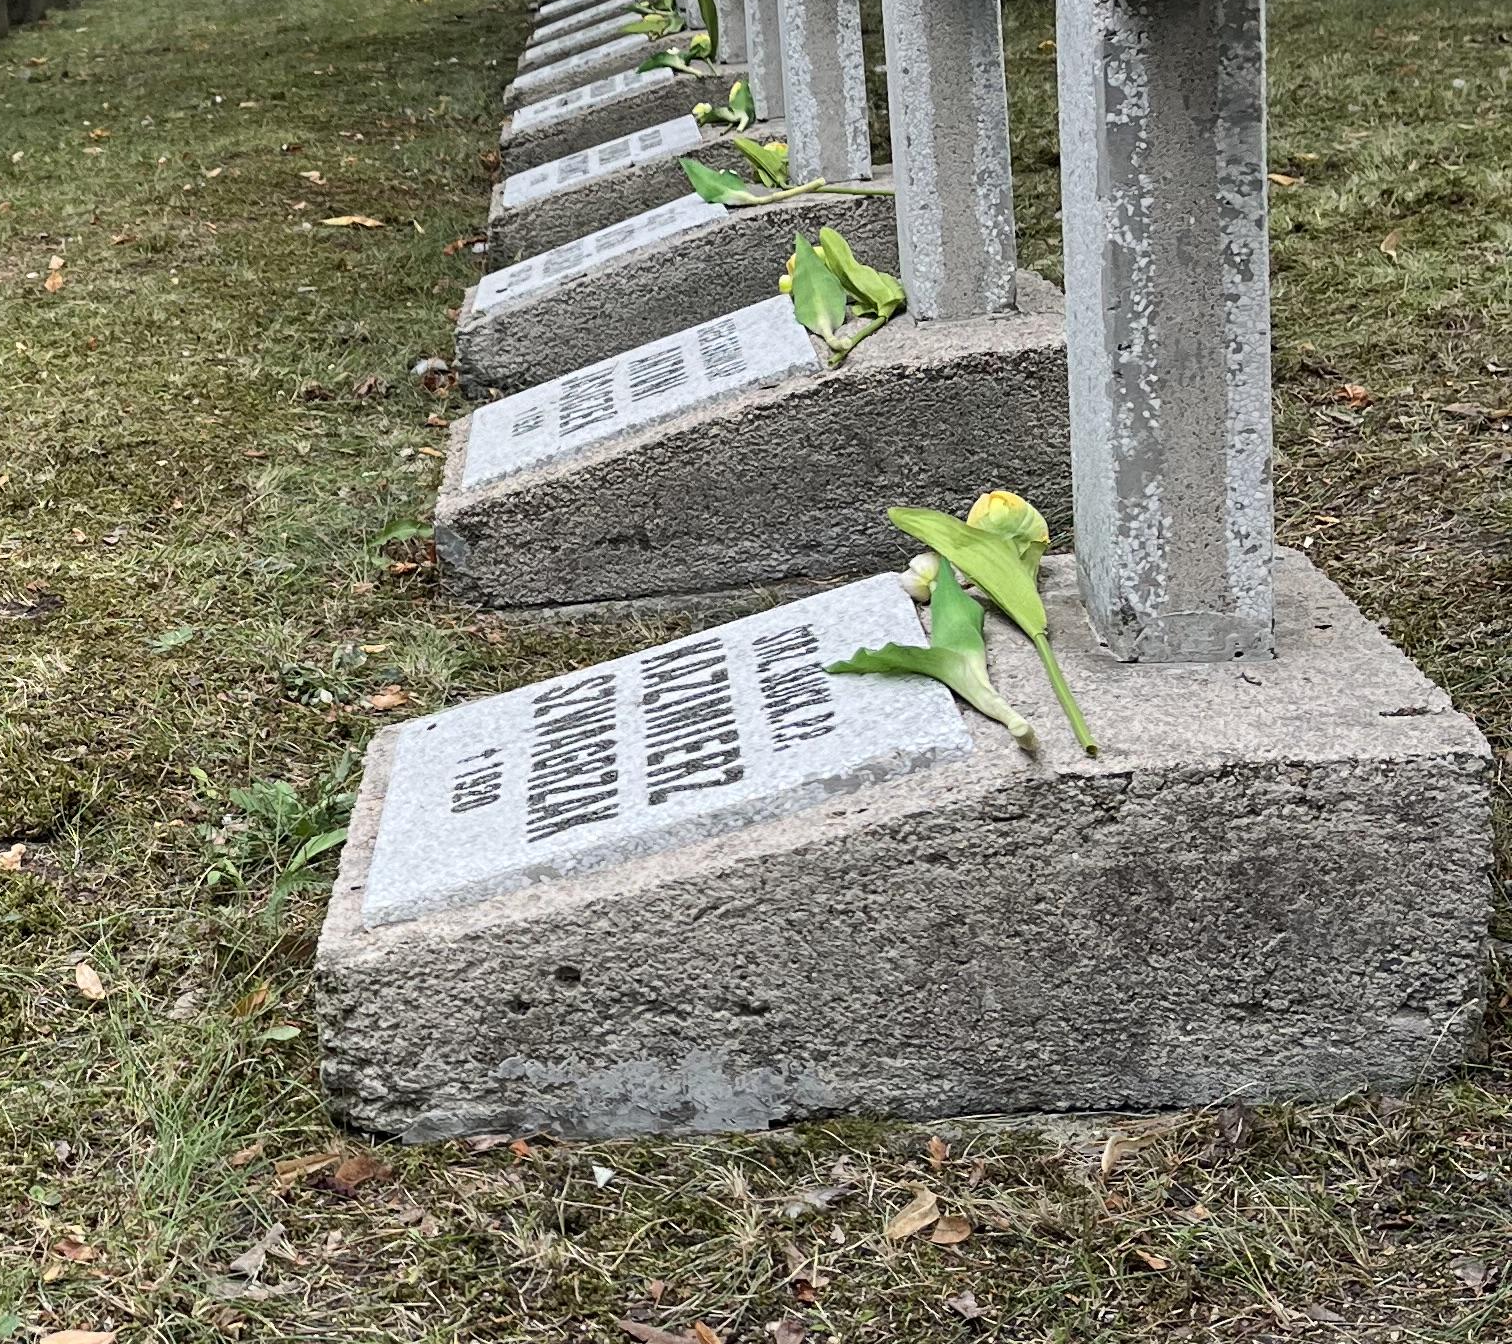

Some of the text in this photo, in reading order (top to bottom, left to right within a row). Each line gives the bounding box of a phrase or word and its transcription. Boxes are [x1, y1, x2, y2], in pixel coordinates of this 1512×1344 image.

[751, 623, 821, 673] STRZ.
[639, 637, 745, 807] KAZIMIERZ
[771, 709, 837, 753] P.P.
[525, 673, 620, 844] SZWAGRZAK
[449, 761, 504, 814] 1920
